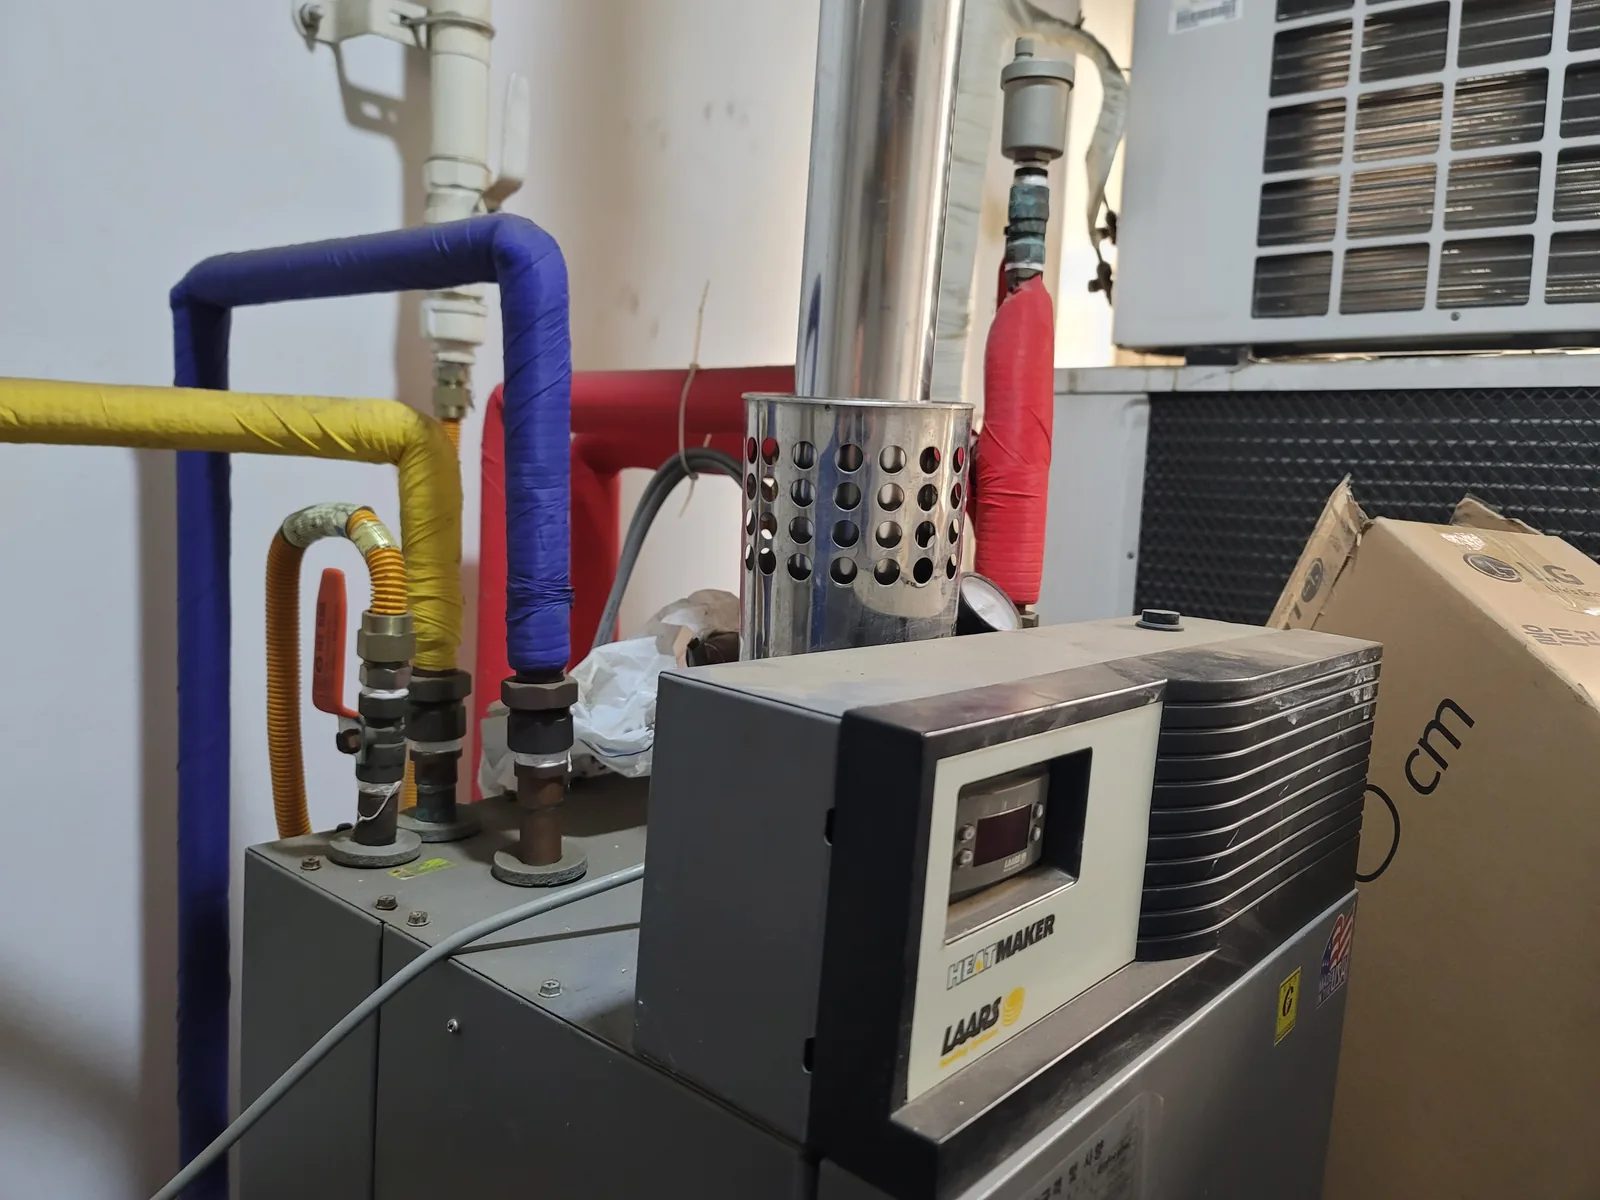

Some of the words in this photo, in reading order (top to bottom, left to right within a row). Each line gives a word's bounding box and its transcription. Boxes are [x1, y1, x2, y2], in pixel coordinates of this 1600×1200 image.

[1405, 698, 1475, 796] cm
[946, 914, 1055, 991] HEATMAKER
[941, 996, 1003, 1057] LAARS
